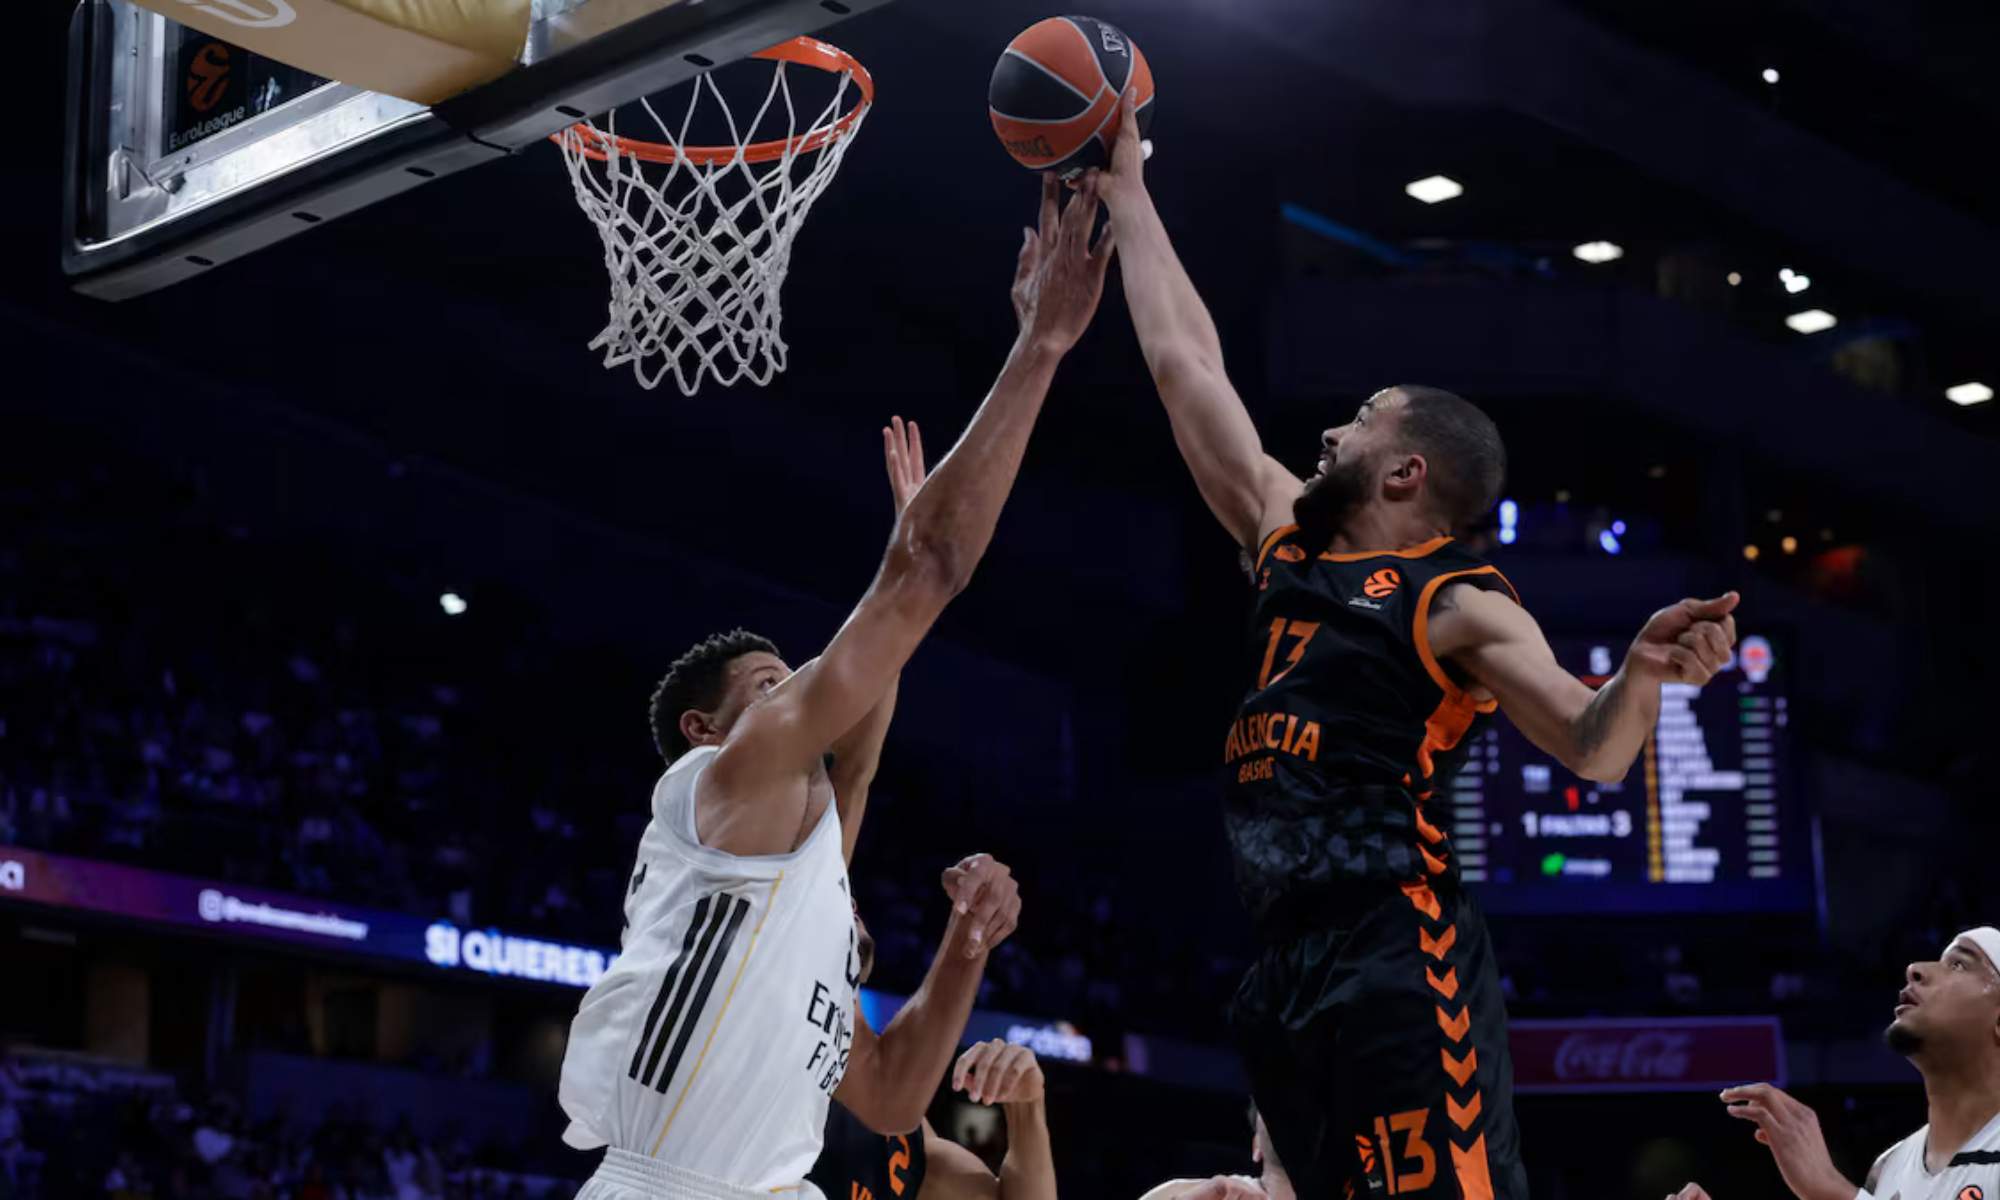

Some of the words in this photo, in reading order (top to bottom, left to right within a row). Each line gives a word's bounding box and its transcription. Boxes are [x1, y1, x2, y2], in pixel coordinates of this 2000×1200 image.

[425, 923, 460, 967] SI
[461, 930, 604, 988] QUIERES
[1374, 1107, 1436, 1196] 13
